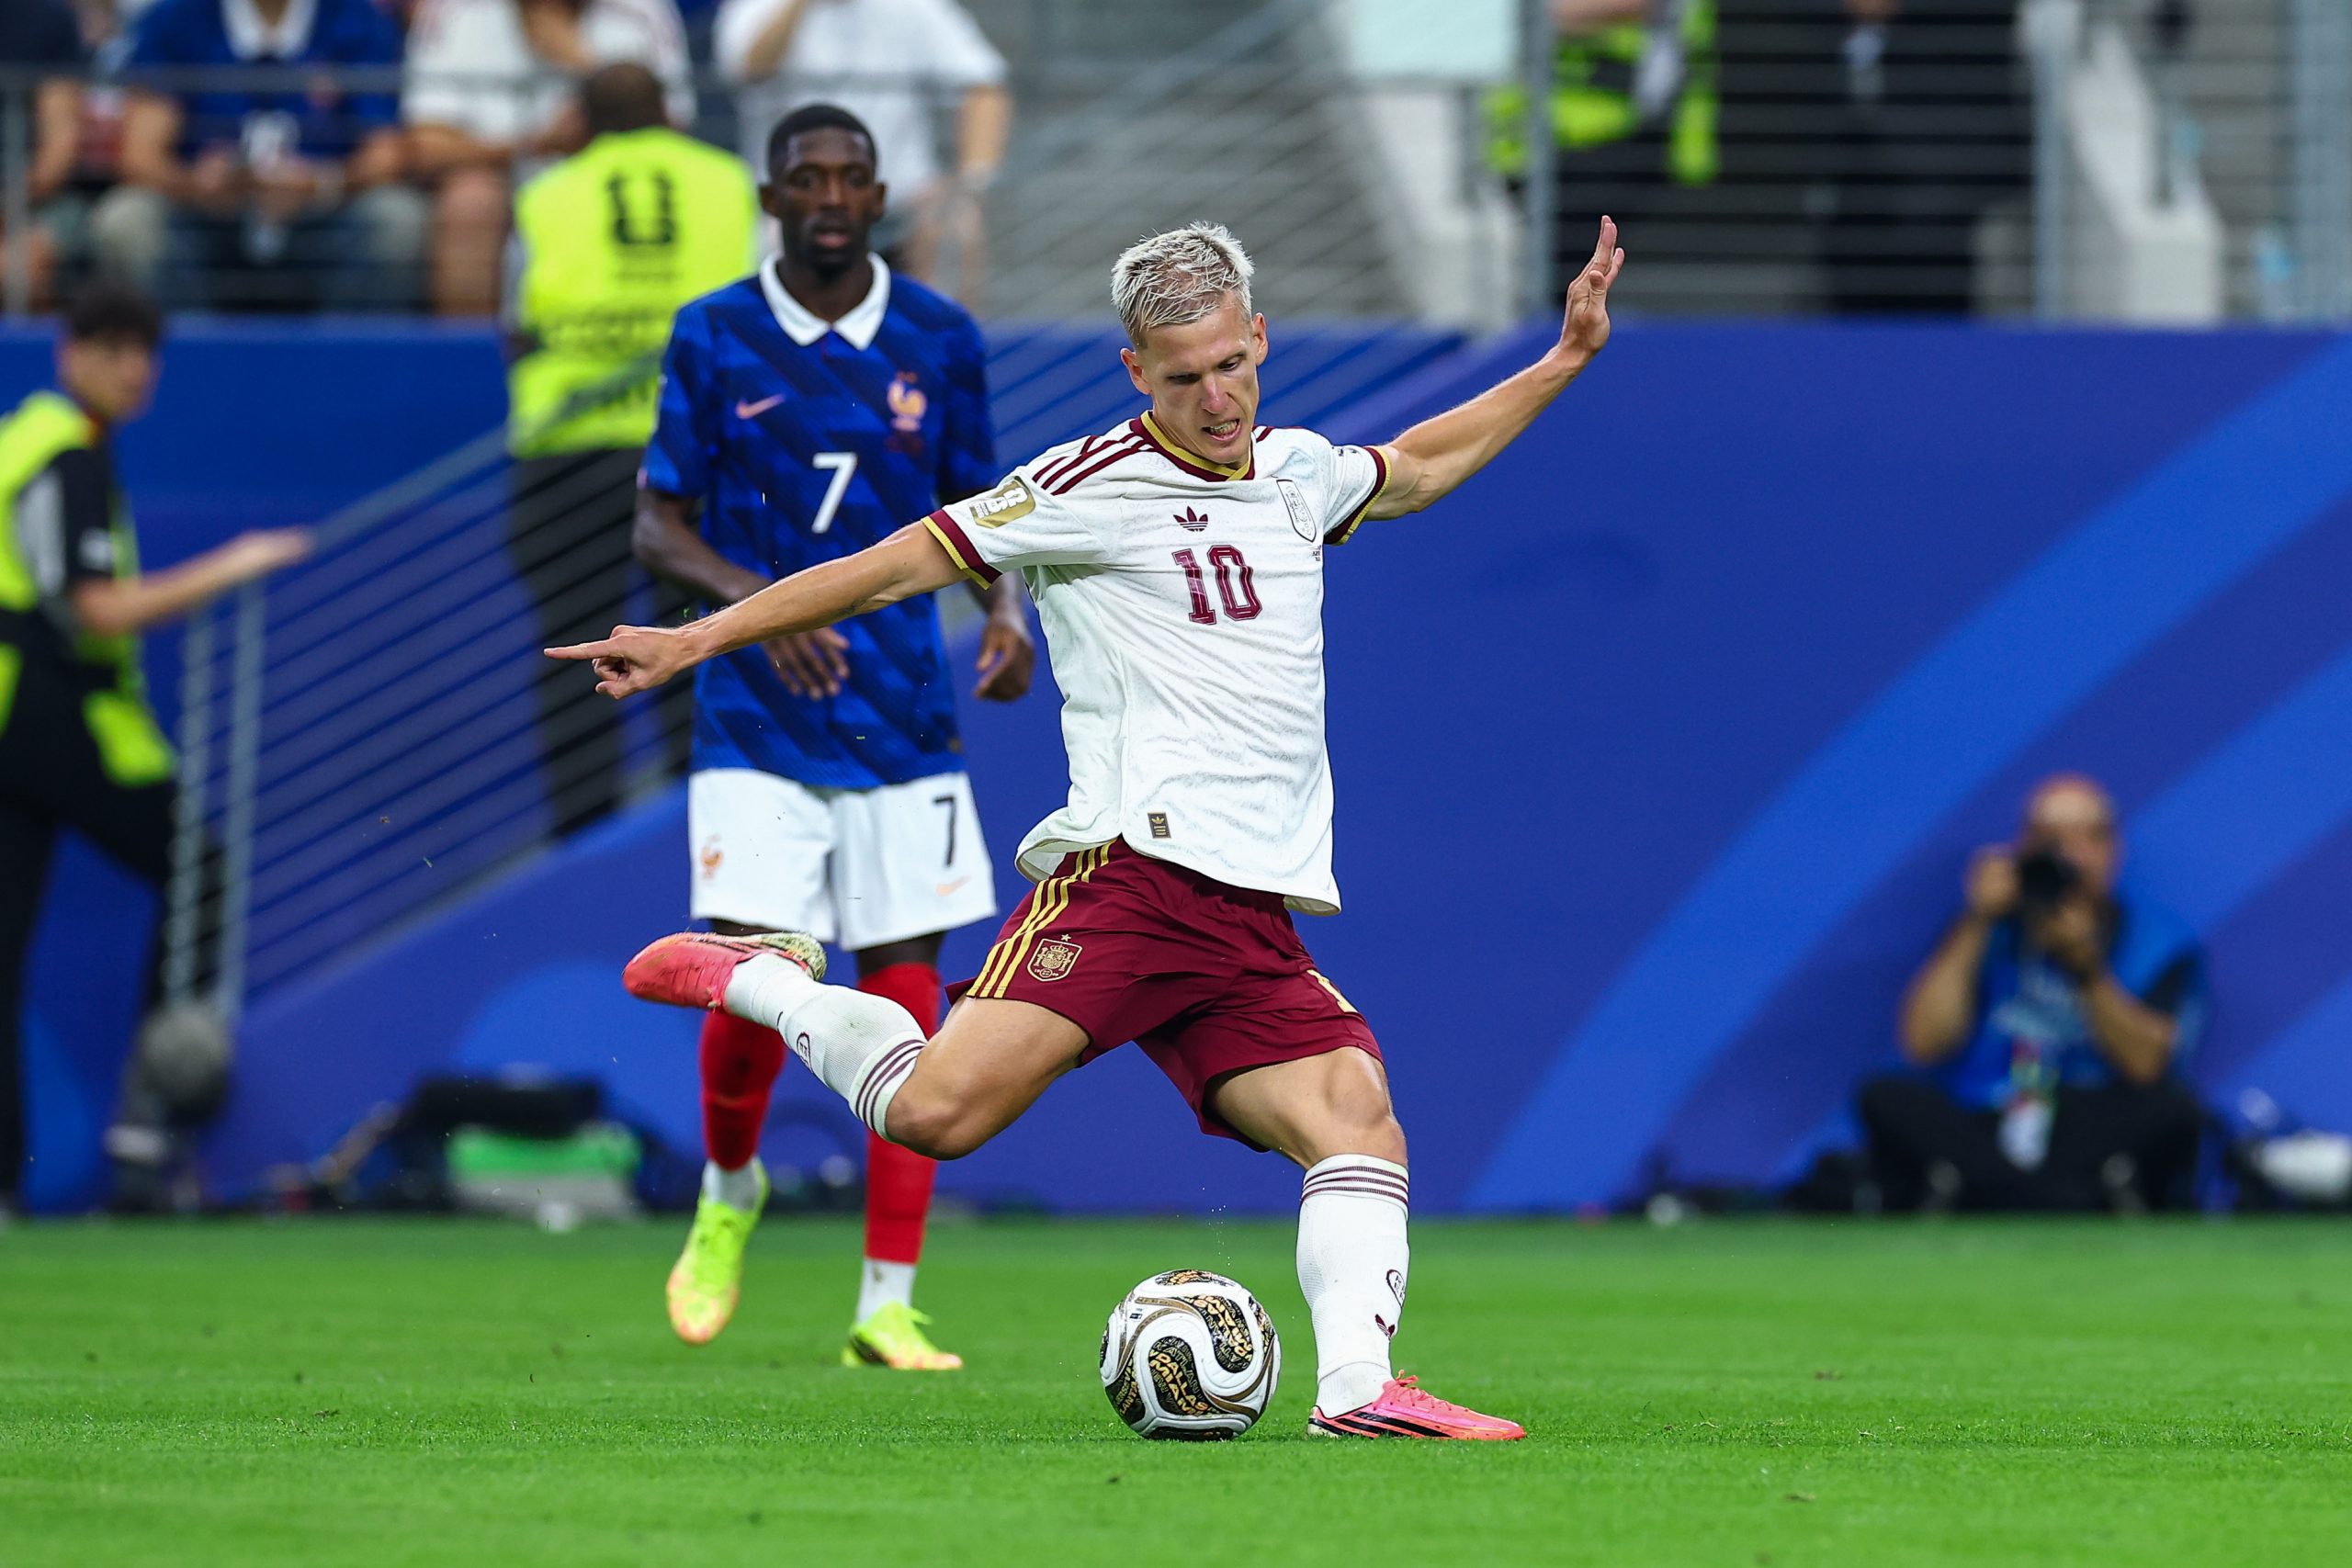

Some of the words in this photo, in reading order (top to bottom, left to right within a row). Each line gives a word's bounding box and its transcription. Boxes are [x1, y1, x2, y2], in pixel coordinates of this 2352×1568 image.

[812, 452, 857, 534] 7
[1172, 544, 1263, 625] 10
[933, 795, 956, 867] 7
[1193, 1299, 1248, 1358] DALLAS
[1156, 1353, 1209, 1412] DALLAS
